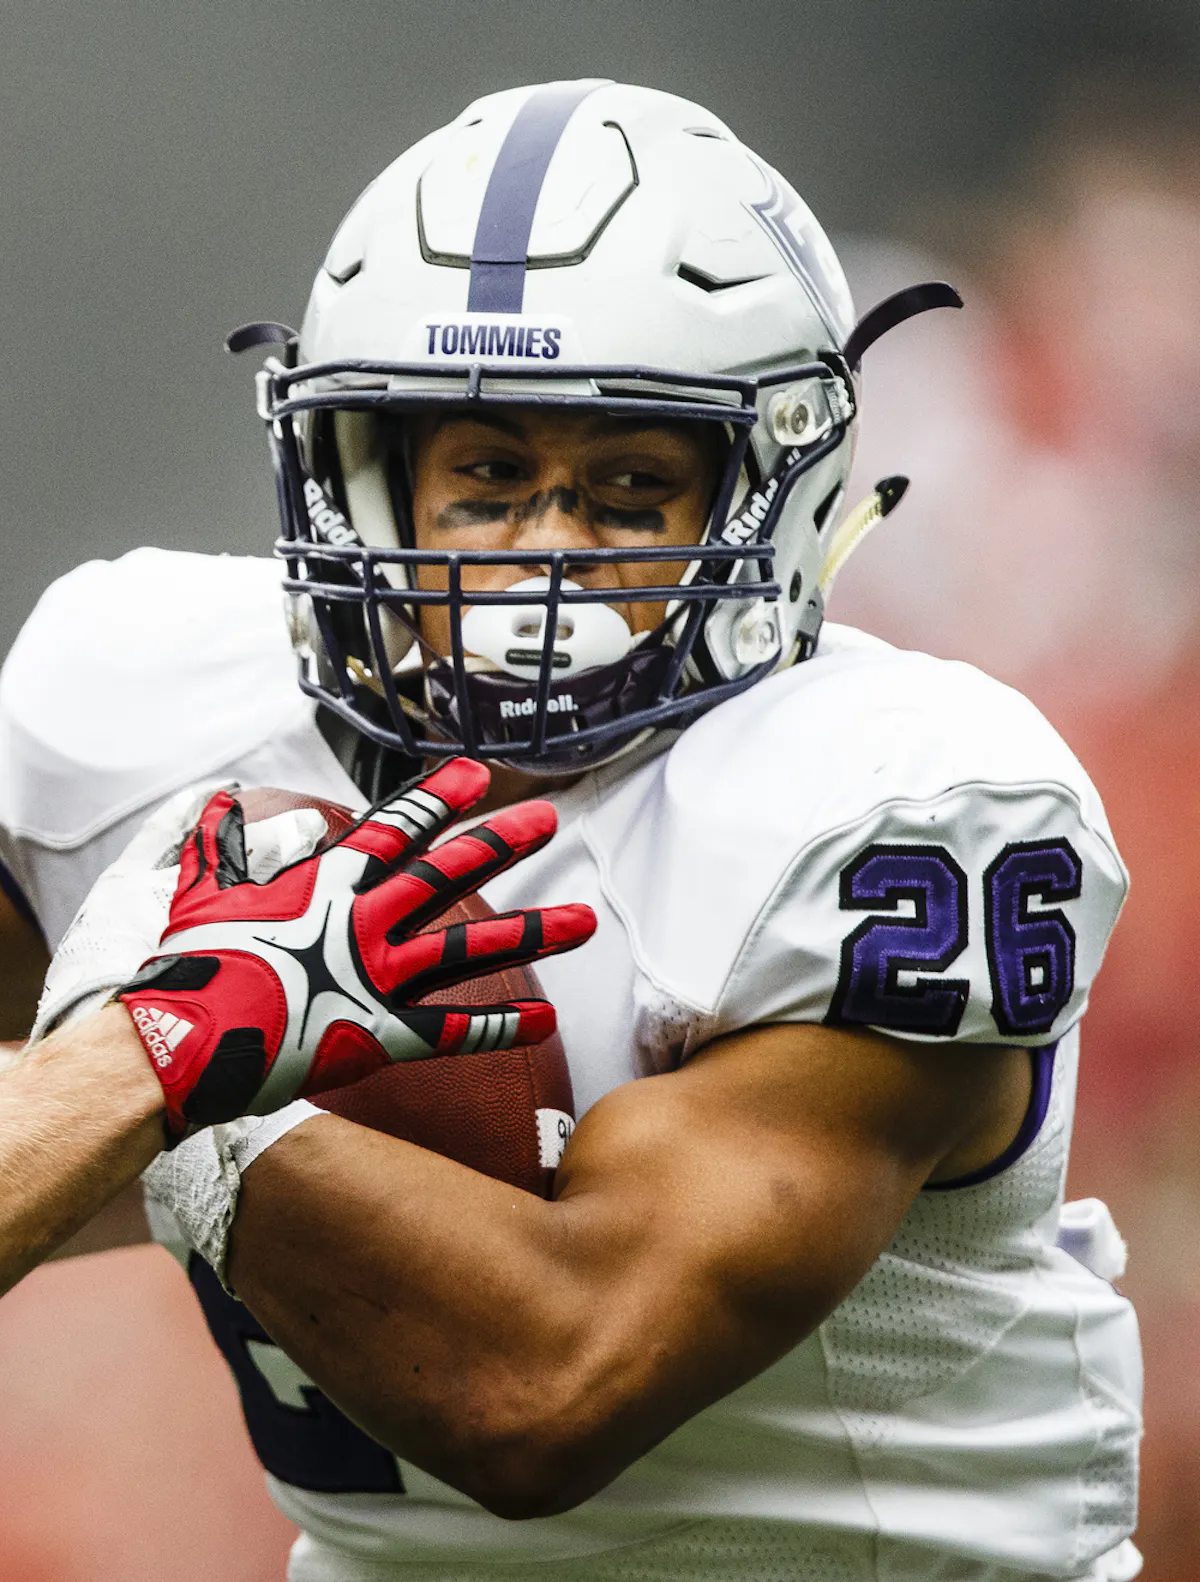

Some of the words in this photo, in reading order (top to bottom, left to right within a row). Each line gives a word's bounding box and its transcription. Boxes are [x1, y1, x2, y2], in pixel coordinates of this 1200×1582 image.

[426, 324, 562, 360] TOMMIES
[822, 836, 1083, 1036] 26
[132, 1006, 173, 1068] adidas
